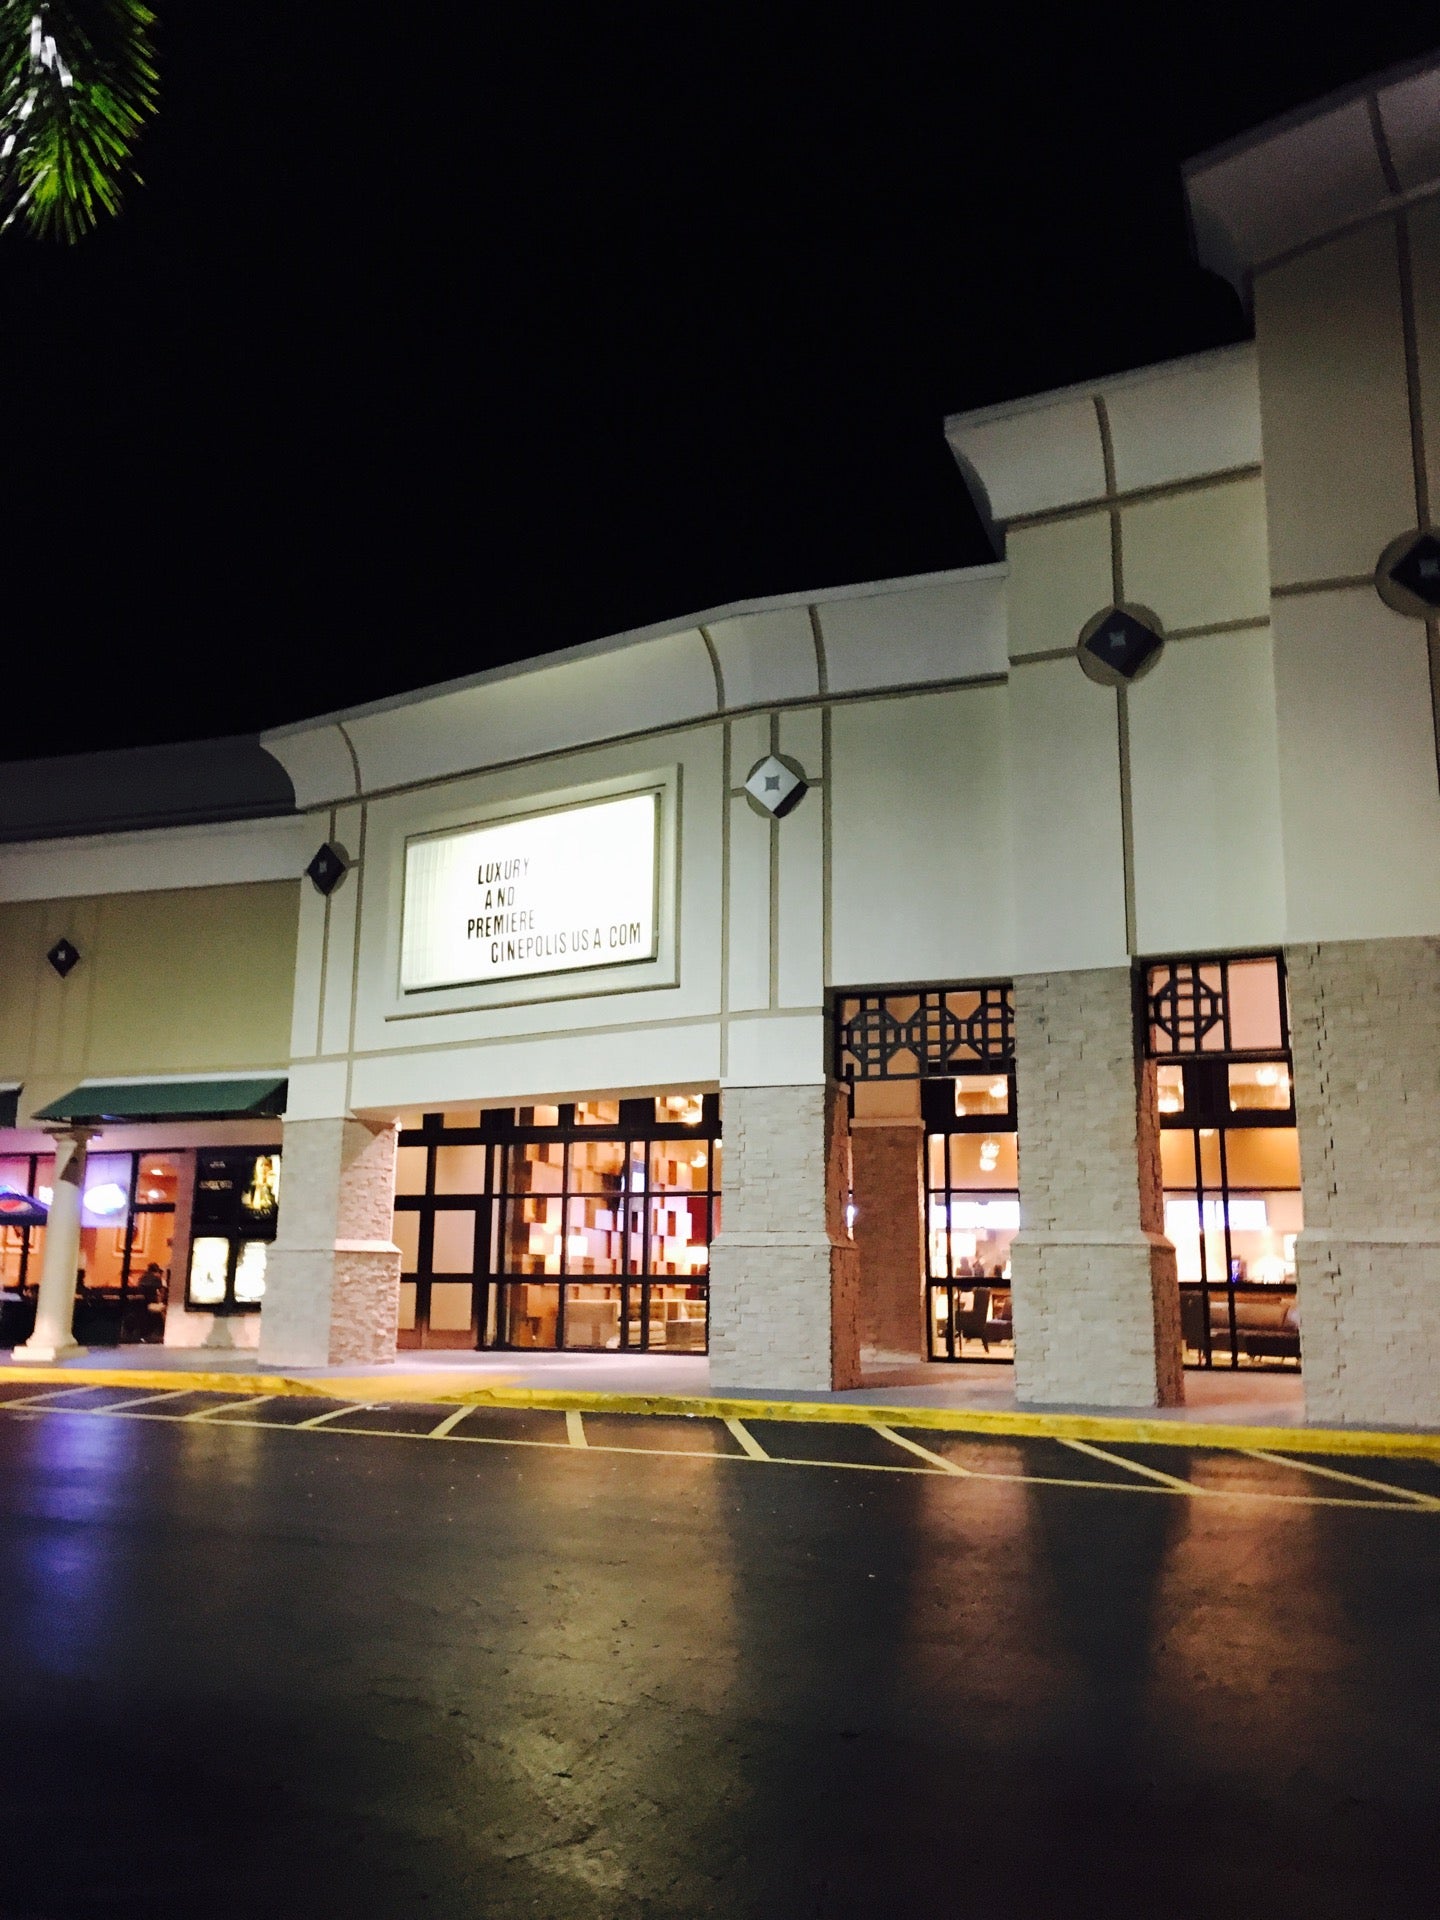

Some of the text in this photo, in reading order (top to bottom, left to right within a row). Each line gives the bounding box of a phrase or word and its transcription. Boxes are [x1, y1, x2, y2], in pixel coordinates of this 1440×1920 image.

[478, 858, 529, 884] LUXURY
[485, 887, 514, 910] AND
[468, 910, 535, 939] PREMIERE
